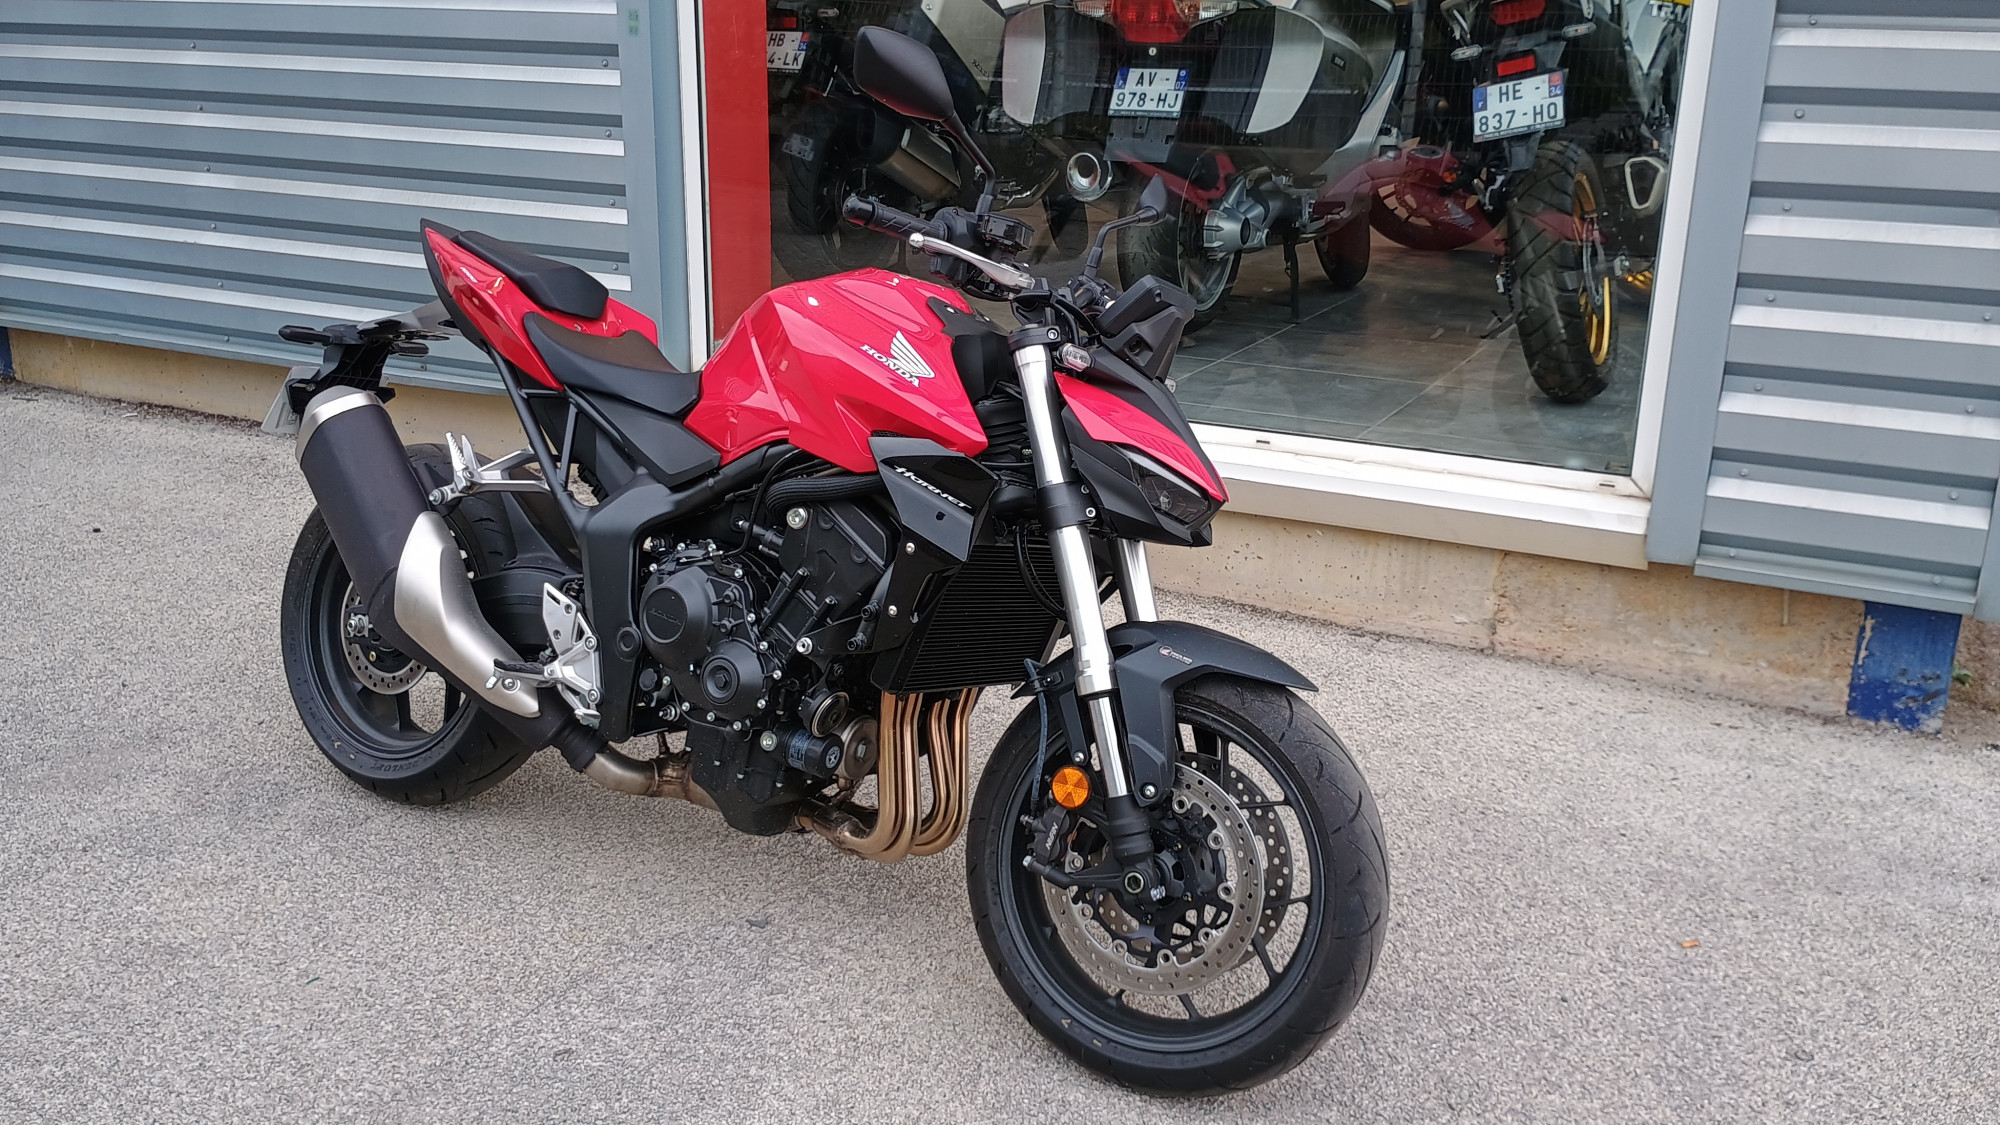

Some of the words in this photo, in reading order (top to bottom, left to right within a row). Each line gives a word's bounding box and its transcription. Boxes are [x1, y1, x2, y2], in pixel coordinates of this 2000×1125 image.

[767, 51, 802, 67] 4-LK
[1175, 81, 1186, 90] 07
[1115, 91, 1179, 109] 978-HJ
[1478, 101, 1558, 133] 837-HQ
[859, 344, 920, 388] HONDA
